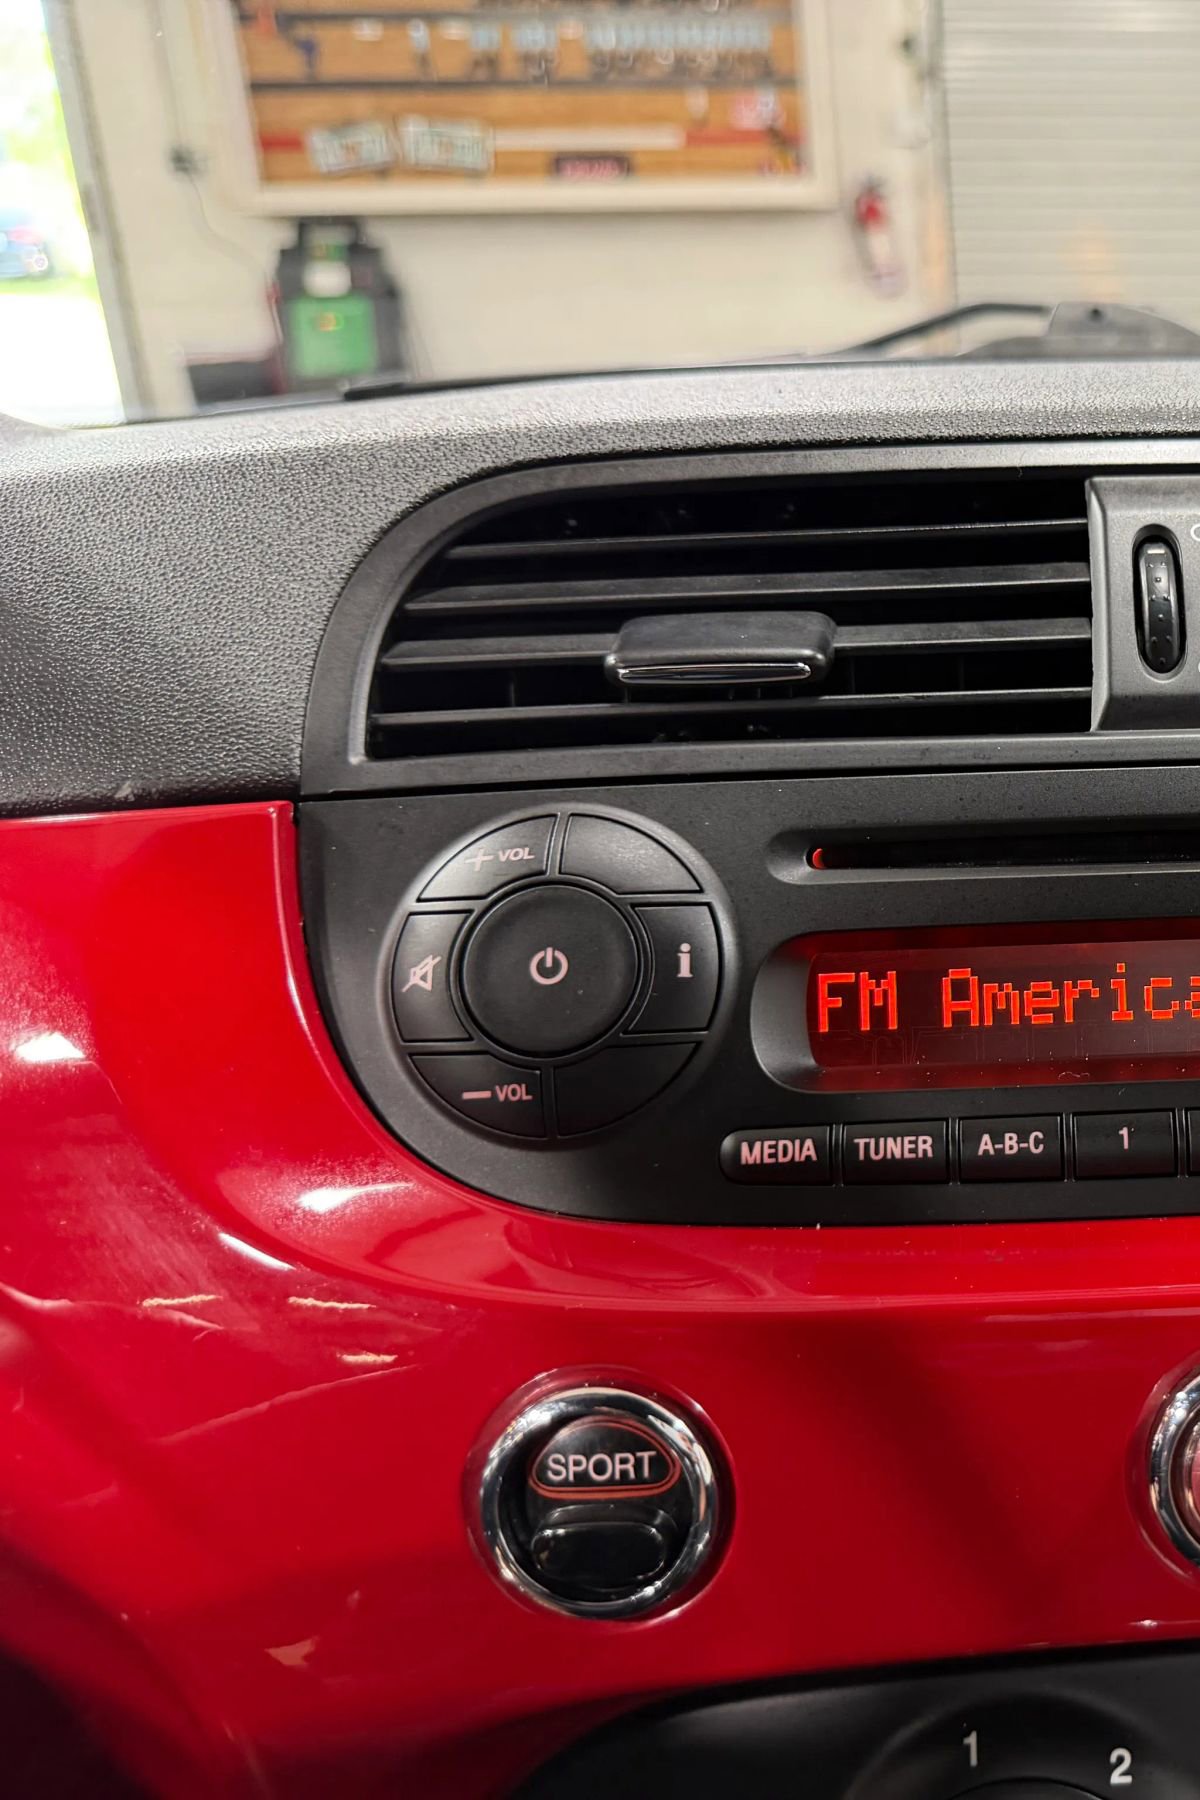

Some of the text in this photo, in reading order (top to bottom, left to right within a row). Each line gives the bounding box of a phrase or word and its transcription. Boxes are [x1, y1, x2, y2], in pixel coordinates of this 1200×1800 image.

[818, 970, 898, 1033] FM
[740, 1138, 818, 1165] MEDIA
[853, 1135, 933, 1161] TUNER
[978, 1131, 1044, 1156] A-B-C
[1118, 1127, 1130, 1150] 1
[546, 1450, 657, 1482] SPORT
[962, 1731, 979, 1767] 1
[1109, 1747, 1134, 1785] 2
